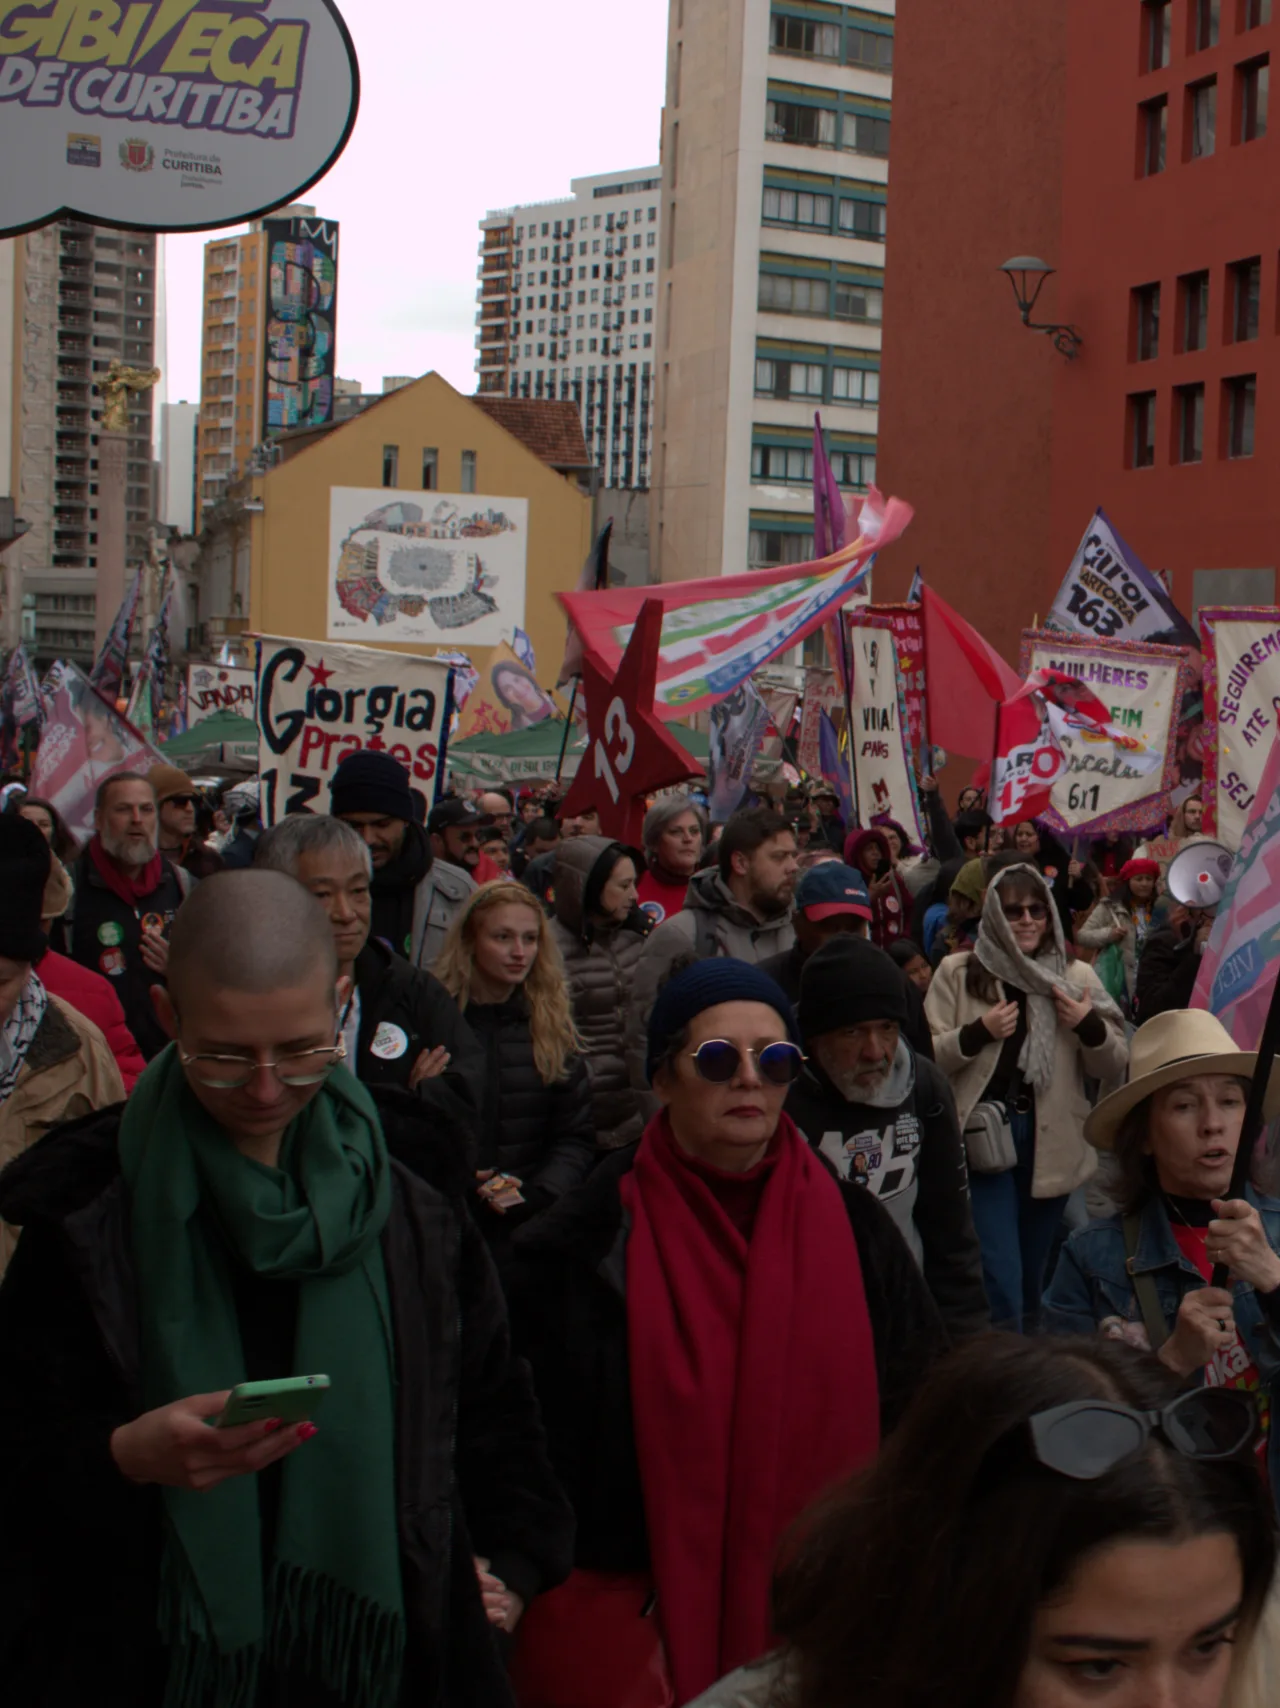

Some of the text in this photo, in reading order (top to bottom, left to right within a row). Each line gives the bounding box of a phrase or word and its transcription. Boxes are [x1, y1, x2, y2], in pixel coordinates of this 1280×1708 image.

[0, 57, 294, 134] DE CURITIBA
[162, 159, 222, 175] CURITIBA
[164, 149, 221, 162] Prefeitura de
[1050, 660, 1149, 690] MULHERES
[260, 648, 436, 754] Giorgia
[1242, 707, 1270, 749] ATE
[594, 696, 635, 805] 13
[1068, 783, 1100, 811] 6x1
[1220, 772, 1256, 811] SEJ
[868, 1152, 882, 1170] 80
